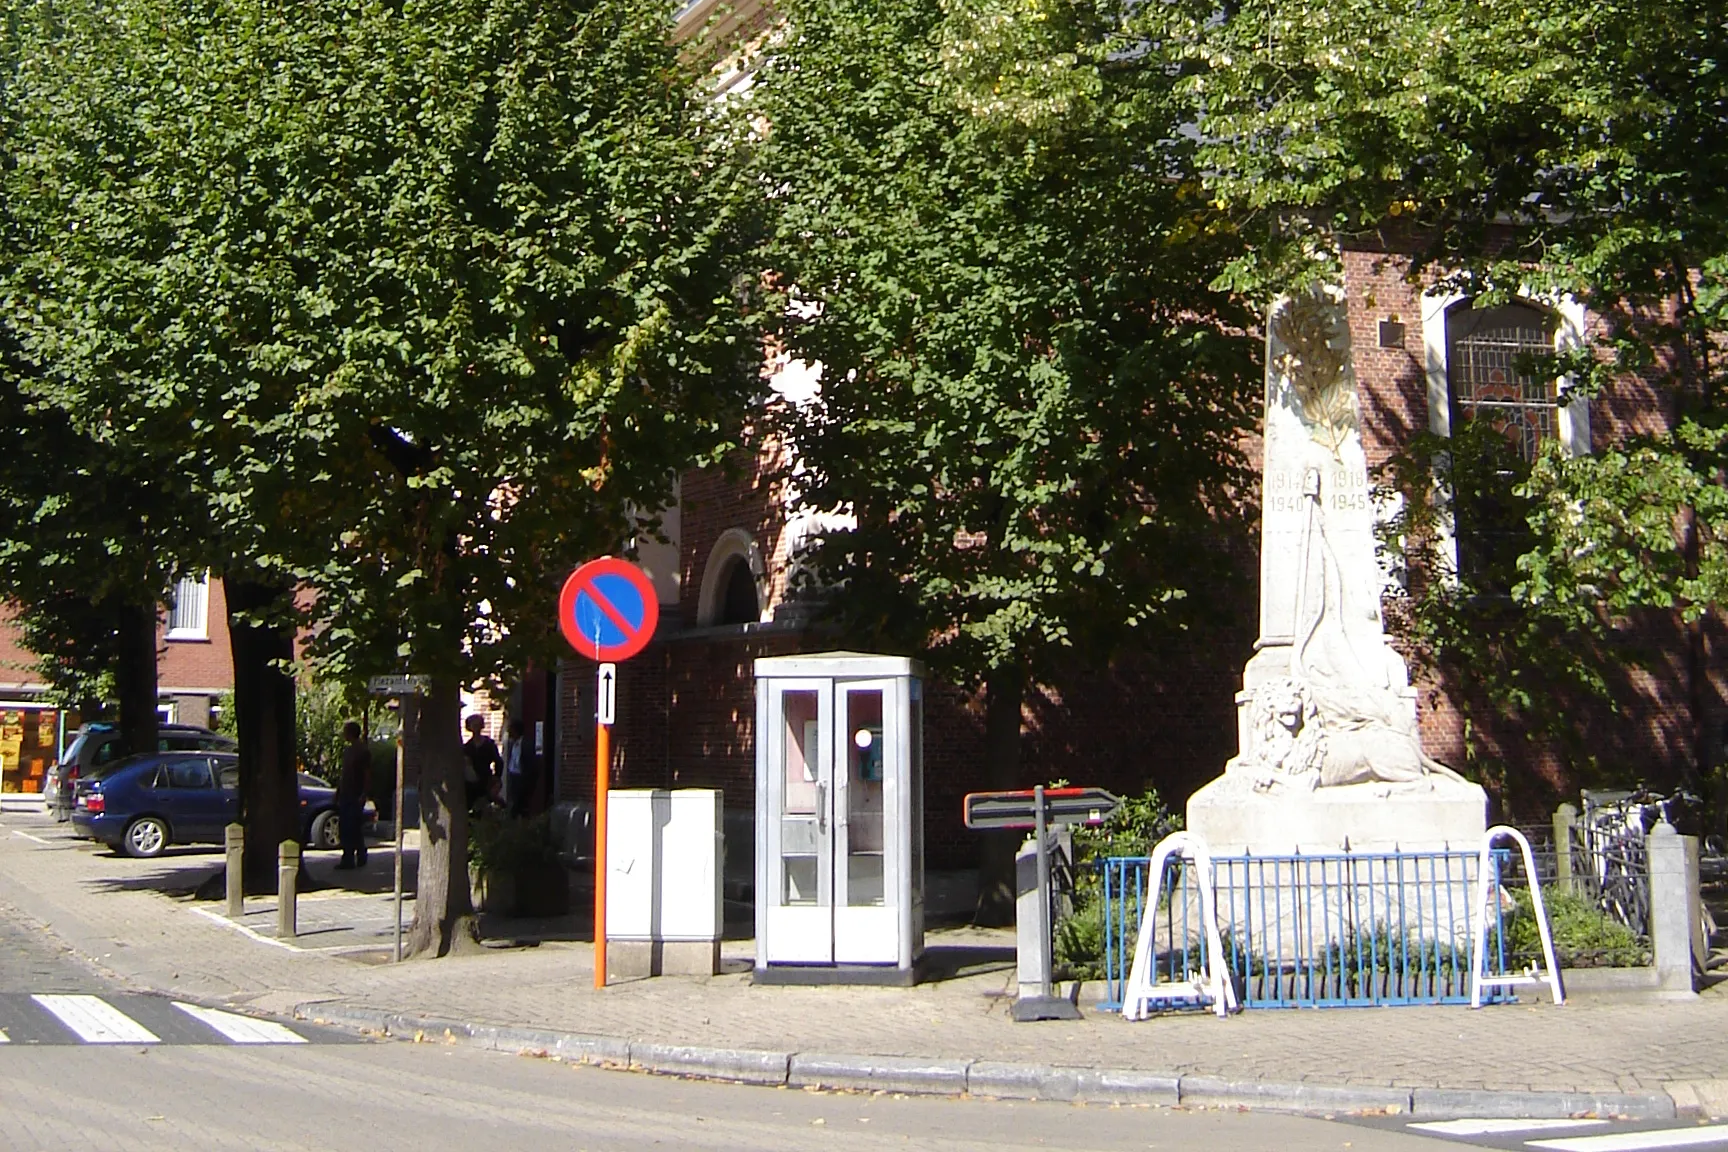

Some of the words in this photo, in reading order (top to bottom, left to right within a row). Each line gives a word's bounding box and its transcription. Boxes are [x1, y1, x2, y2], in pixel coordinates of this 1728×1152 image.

[1331, 470, 1364, 488] 1918
[1269, 495, 1304, 512] 1940
[1329, 493, 1366, 510] 1945
